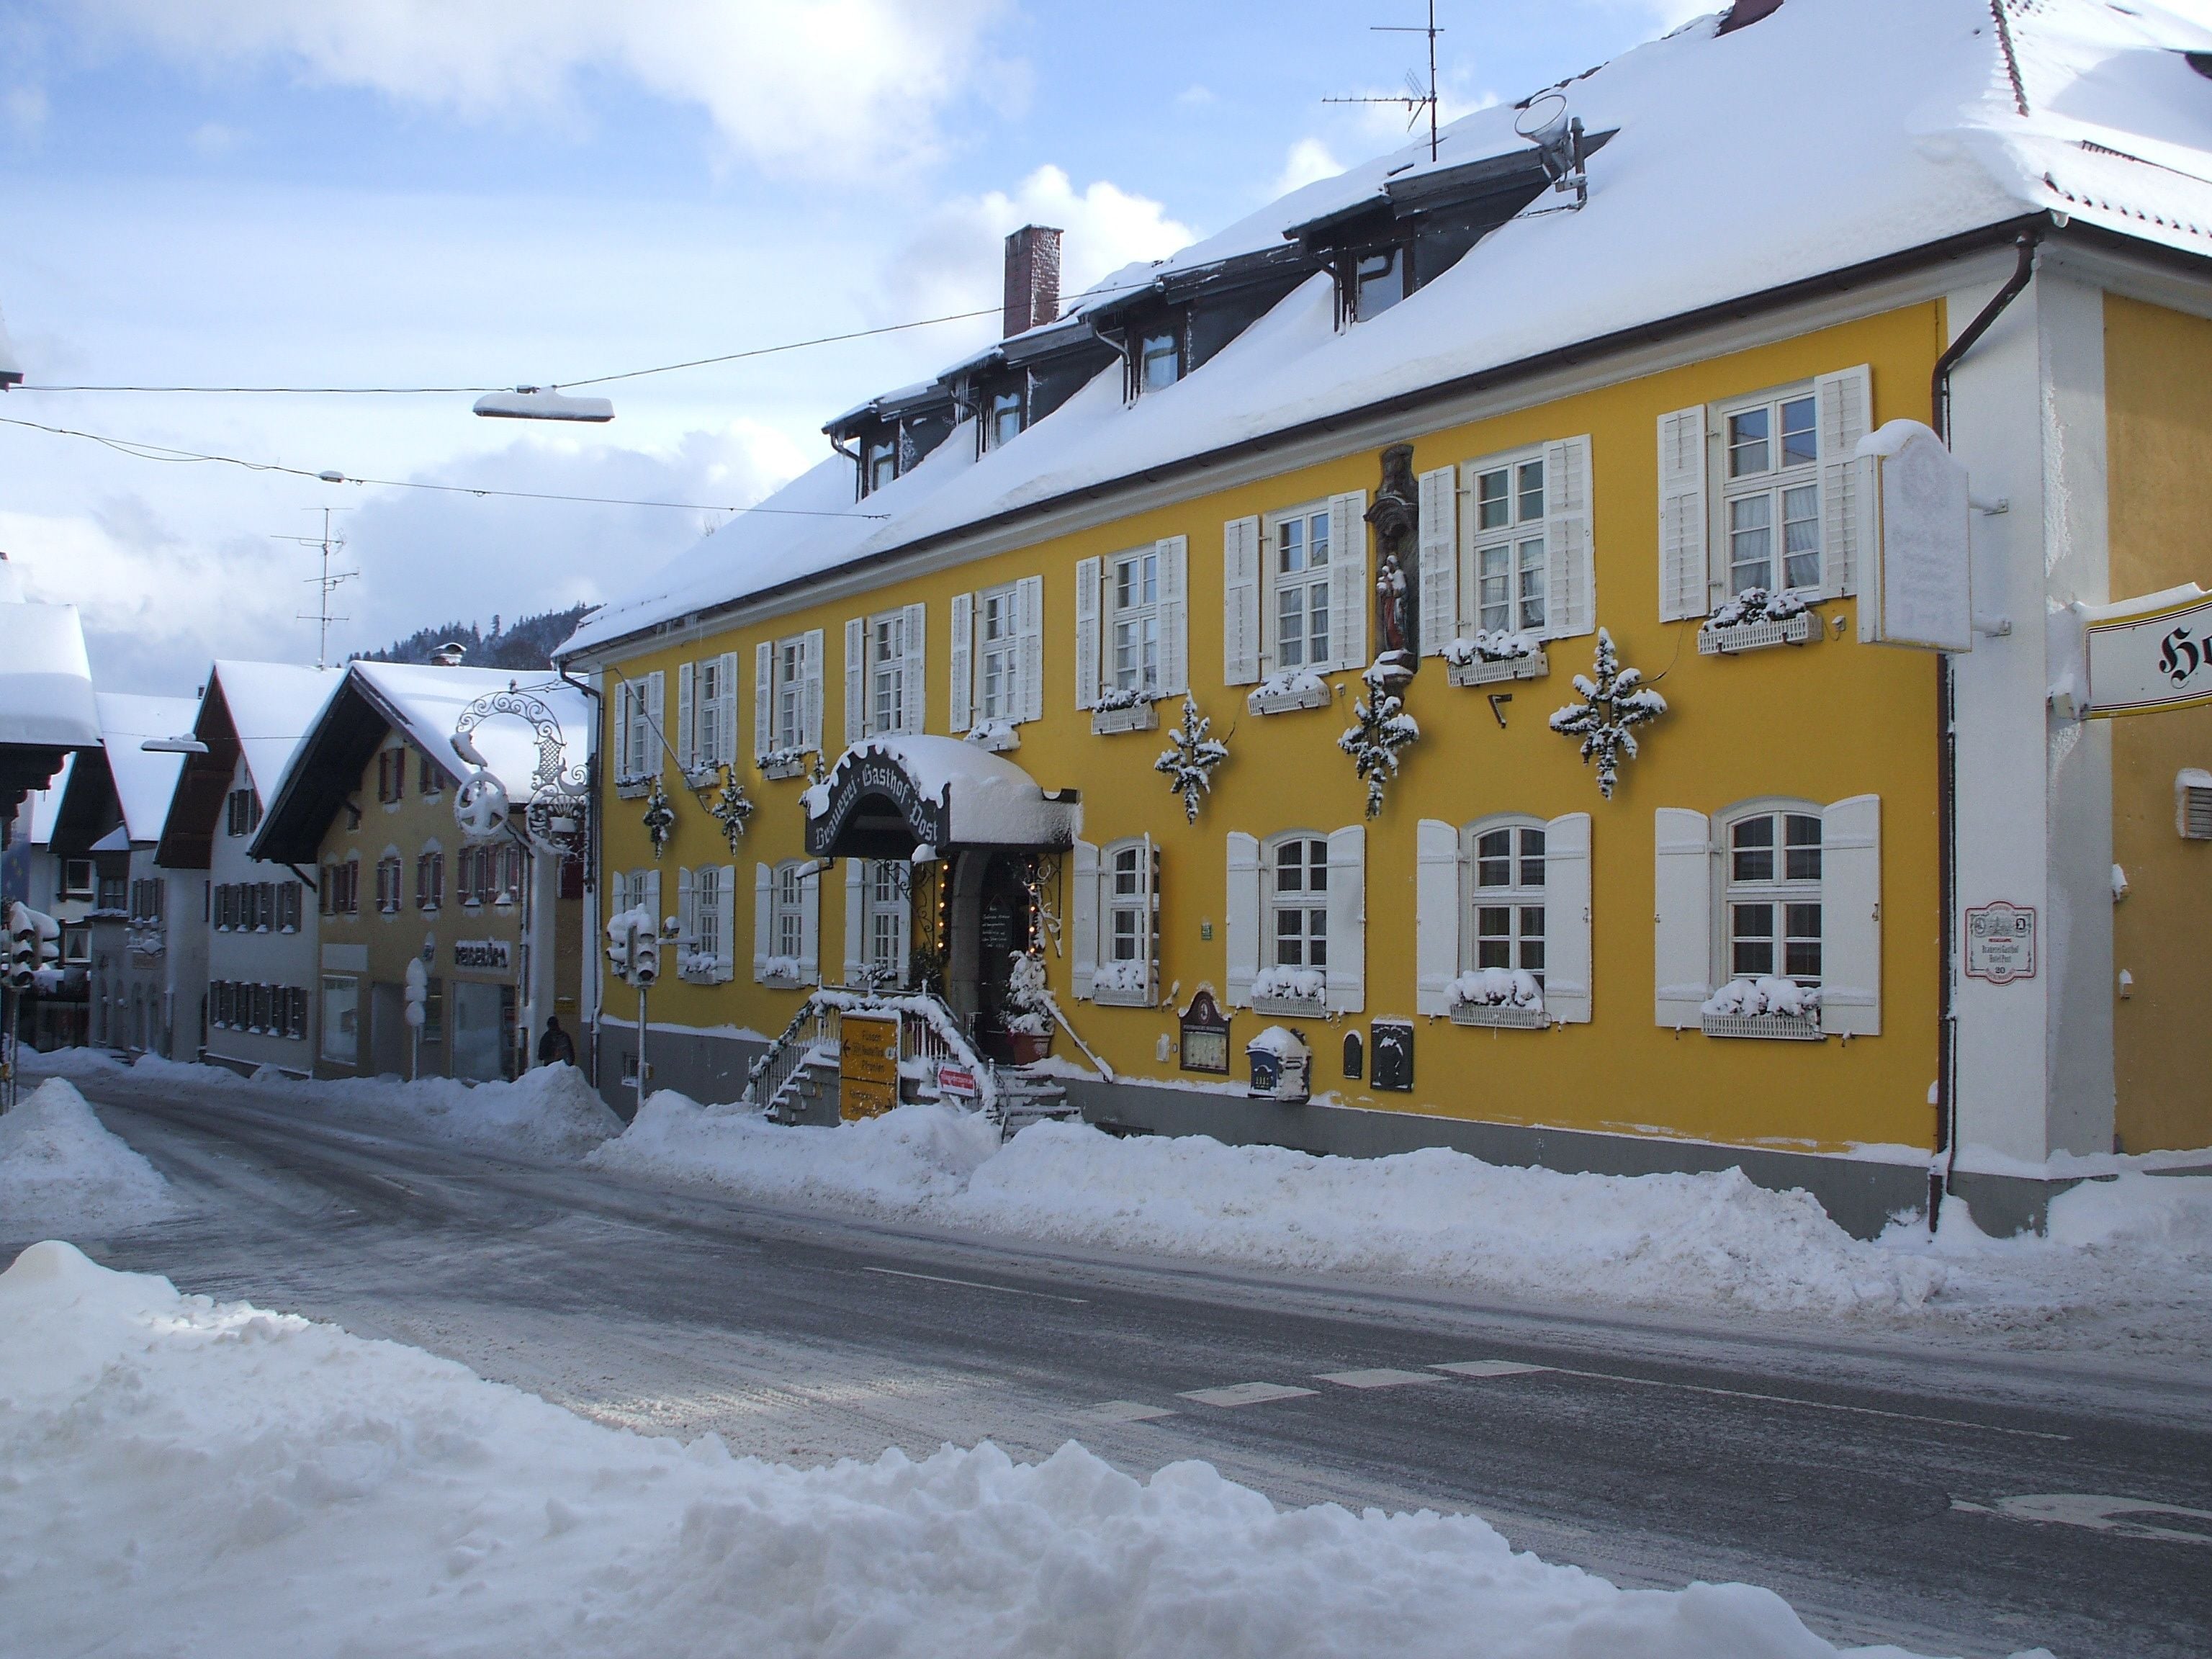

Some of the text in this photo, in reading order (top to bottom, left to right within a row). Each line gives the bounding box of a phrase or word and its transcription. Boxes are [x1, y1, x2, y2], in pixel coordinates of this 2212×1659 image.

[815, 763, 938, 850] Brauerei Gasthof Post
